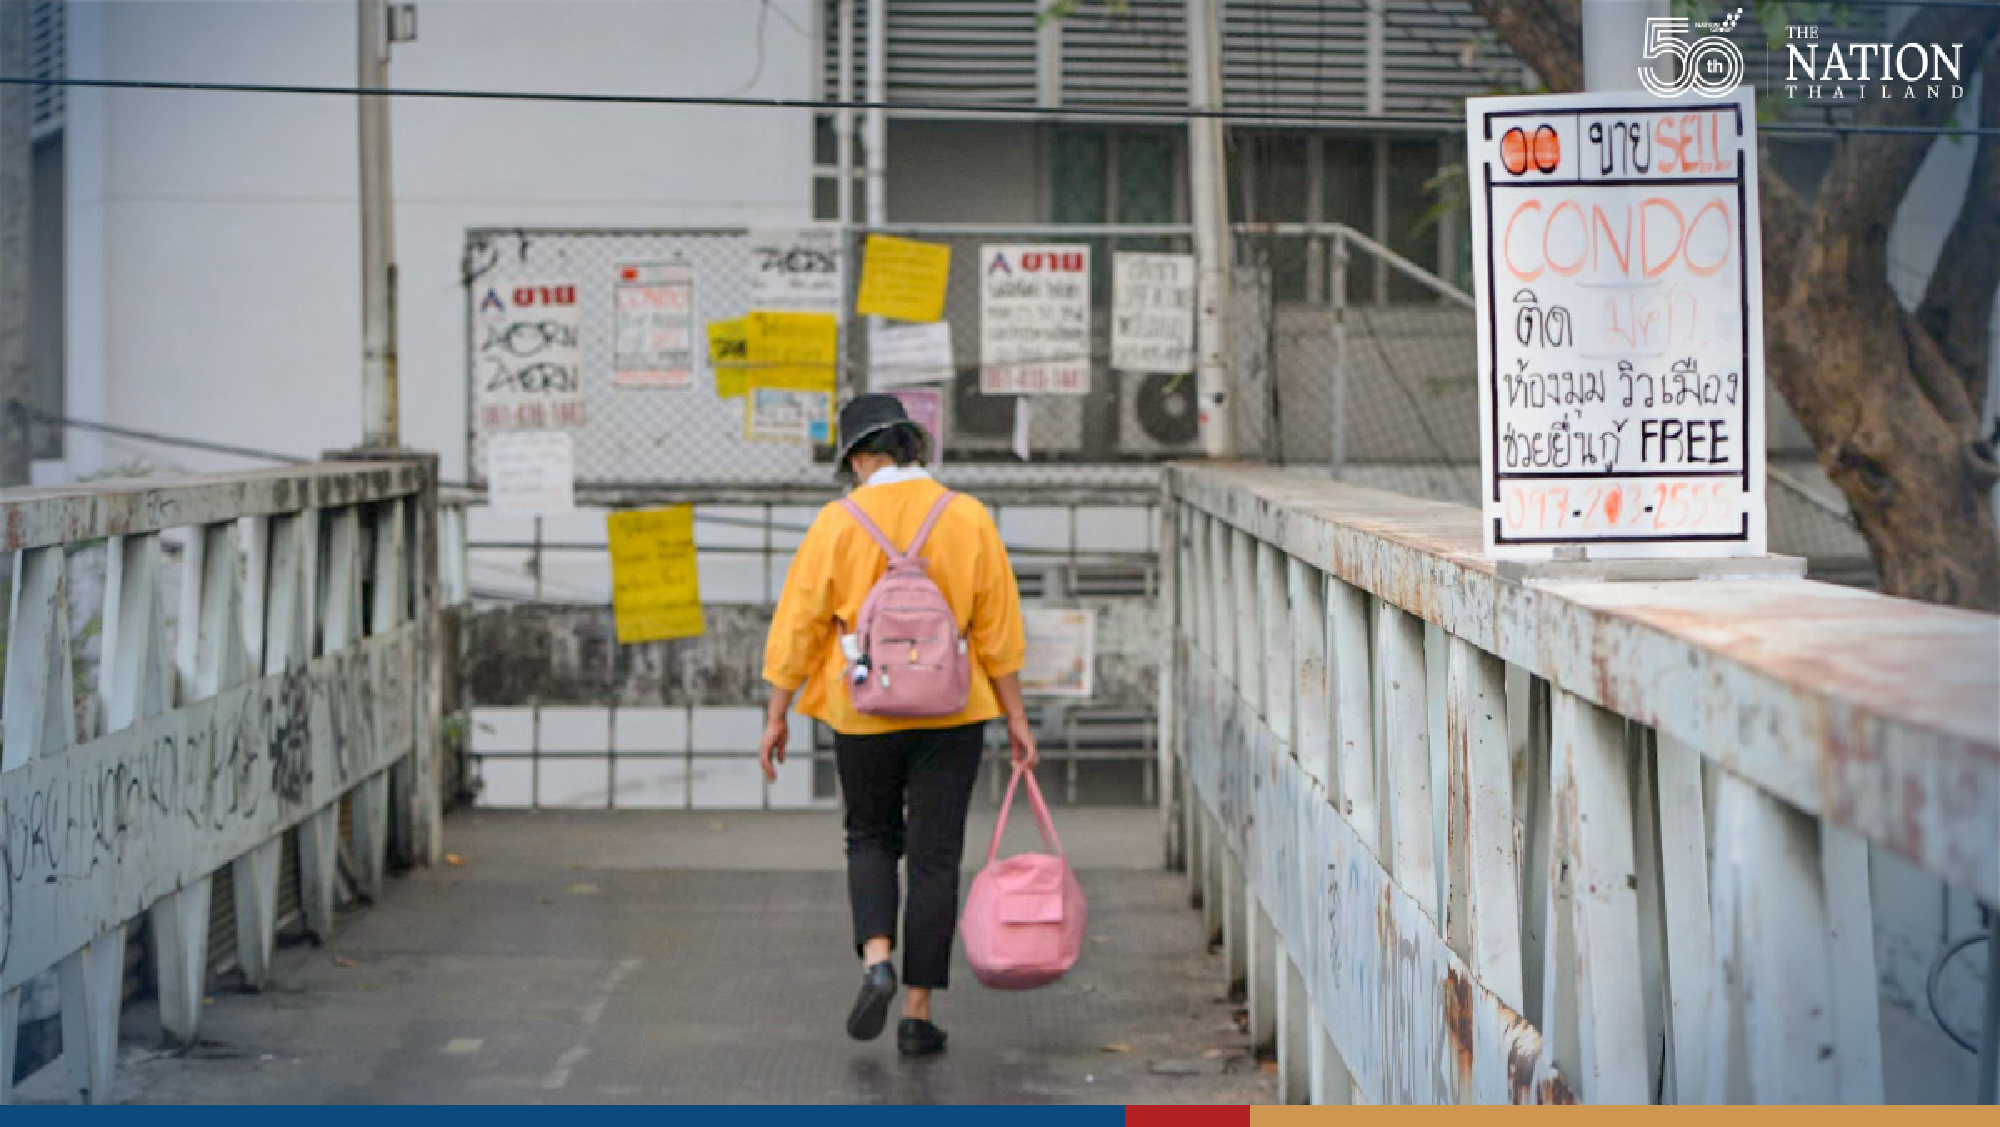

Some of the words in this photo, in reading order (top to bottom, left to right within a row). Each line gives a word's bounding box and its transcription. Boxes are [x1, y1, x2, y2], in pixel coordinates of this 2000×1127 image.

[1589, 120, 1651, 176] ขาย
[1654, 110, 1732, 174] SELL
[1504, 197, 1732, 283] CONDO
[1512, 288, 1573, 348] ติด
[1641, 418, 1729, 463] FREE
